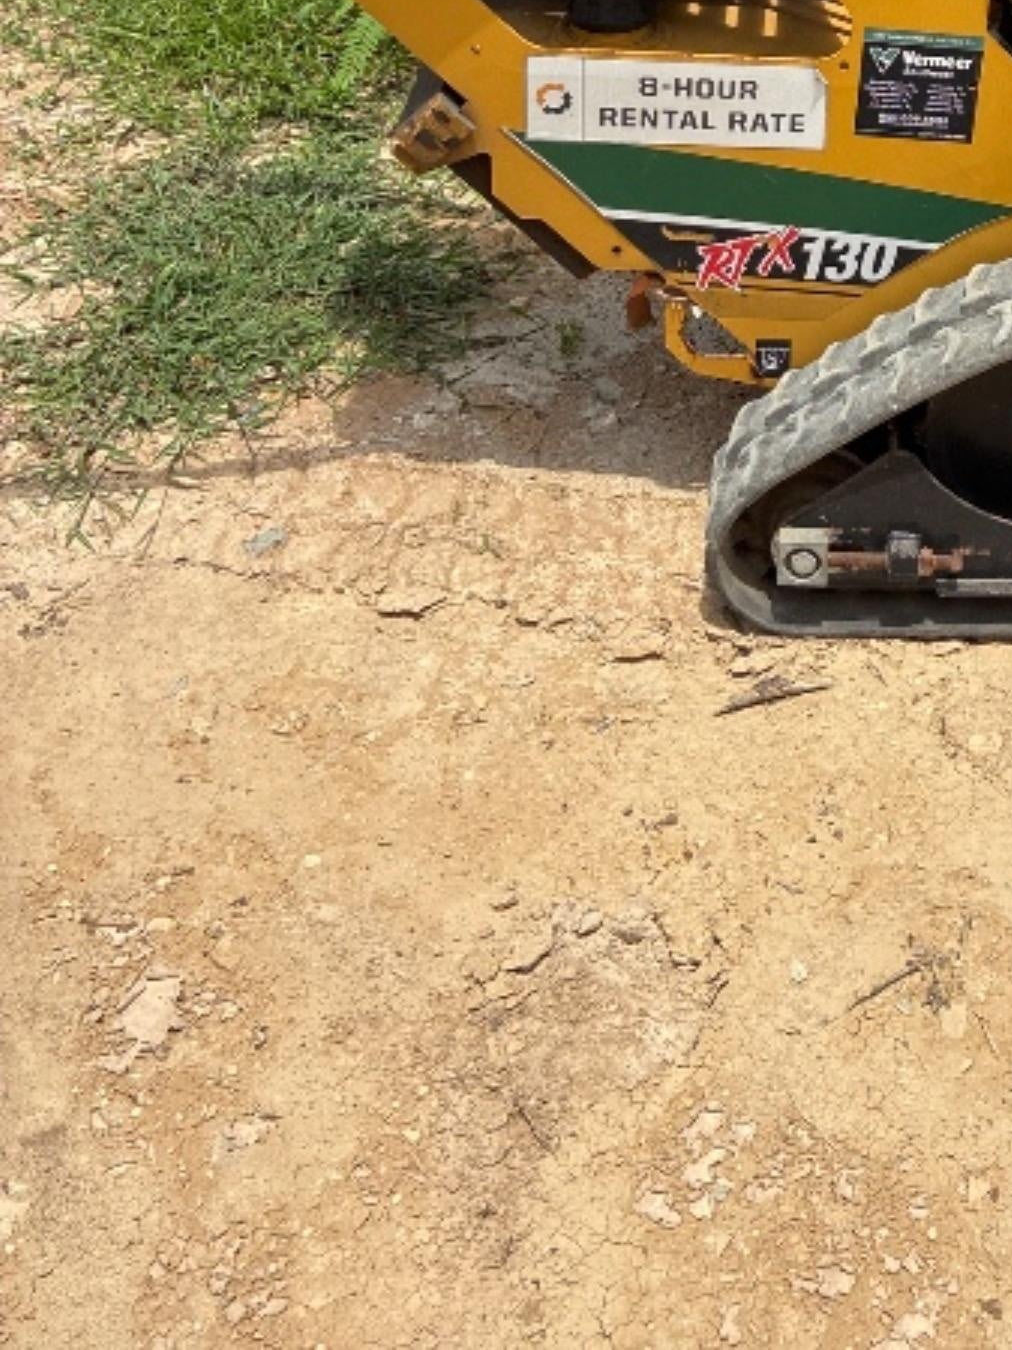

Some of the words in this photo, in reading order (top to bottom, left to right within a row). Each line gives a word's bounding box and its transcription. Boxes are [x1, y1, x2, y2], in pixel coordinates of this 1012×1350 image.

[902, 50, 973, 70] Vermeer
[637, 76, 758, 100] 8-HOUR
[598, 106, 716, 131] RENTAL
[727, 112, 805, 133] RATE
[801, 233, 898, 282] 130
